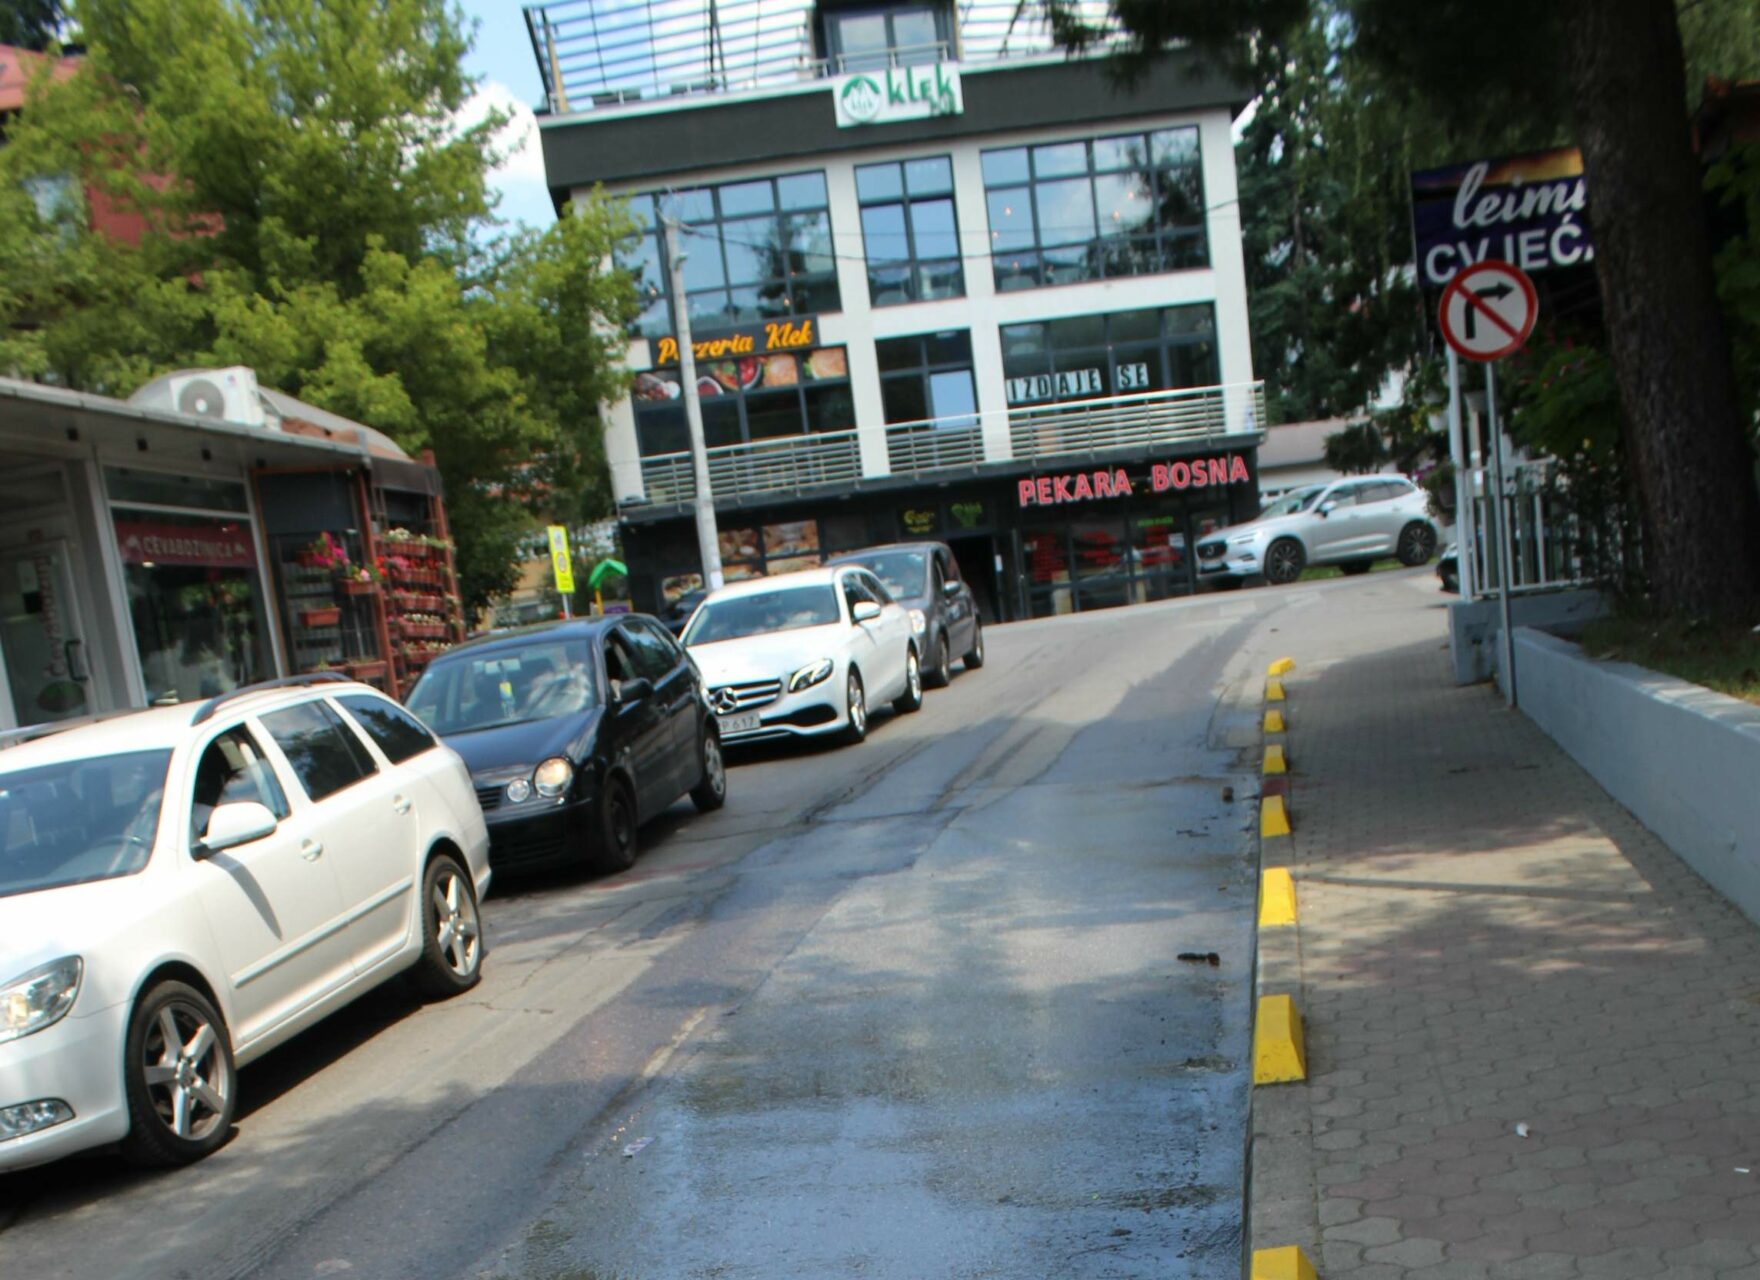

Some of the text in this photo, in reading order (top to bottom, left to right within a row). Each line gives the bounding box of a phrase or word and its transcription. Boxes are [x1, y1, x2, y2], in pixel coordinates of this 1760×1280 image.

[765, 319, 813, 350] Klek
[1009, 363, 1147, 401] IZDAJE SE
[1018, 455, 1249, 507] PEKARA BOSNA
